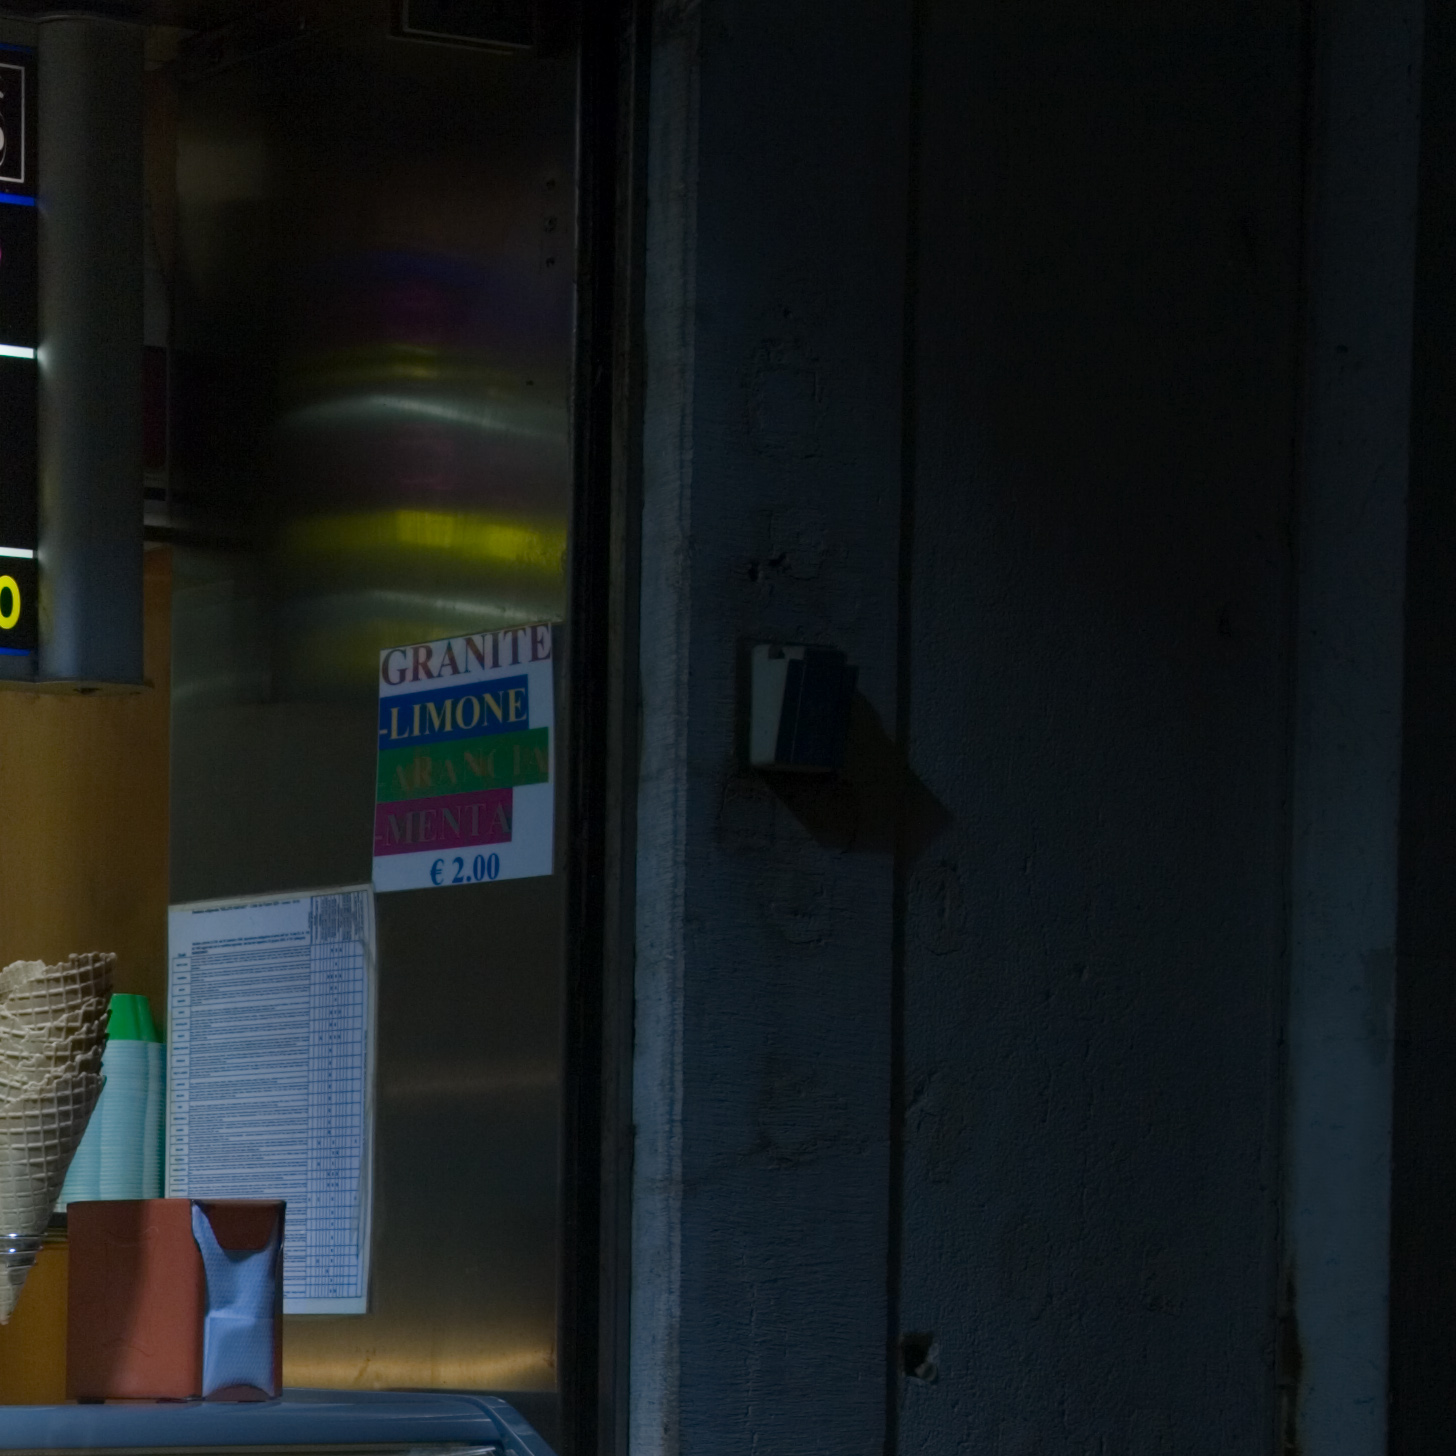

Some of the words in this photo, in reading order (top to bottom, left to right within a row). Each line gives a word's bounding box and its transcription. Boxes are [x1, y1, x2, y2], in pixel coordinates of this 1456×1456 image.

[382, 623, 551, 686] GRANITE
[430, 858, 445, 886] €
[452, 853, 500, 883] 2.00
